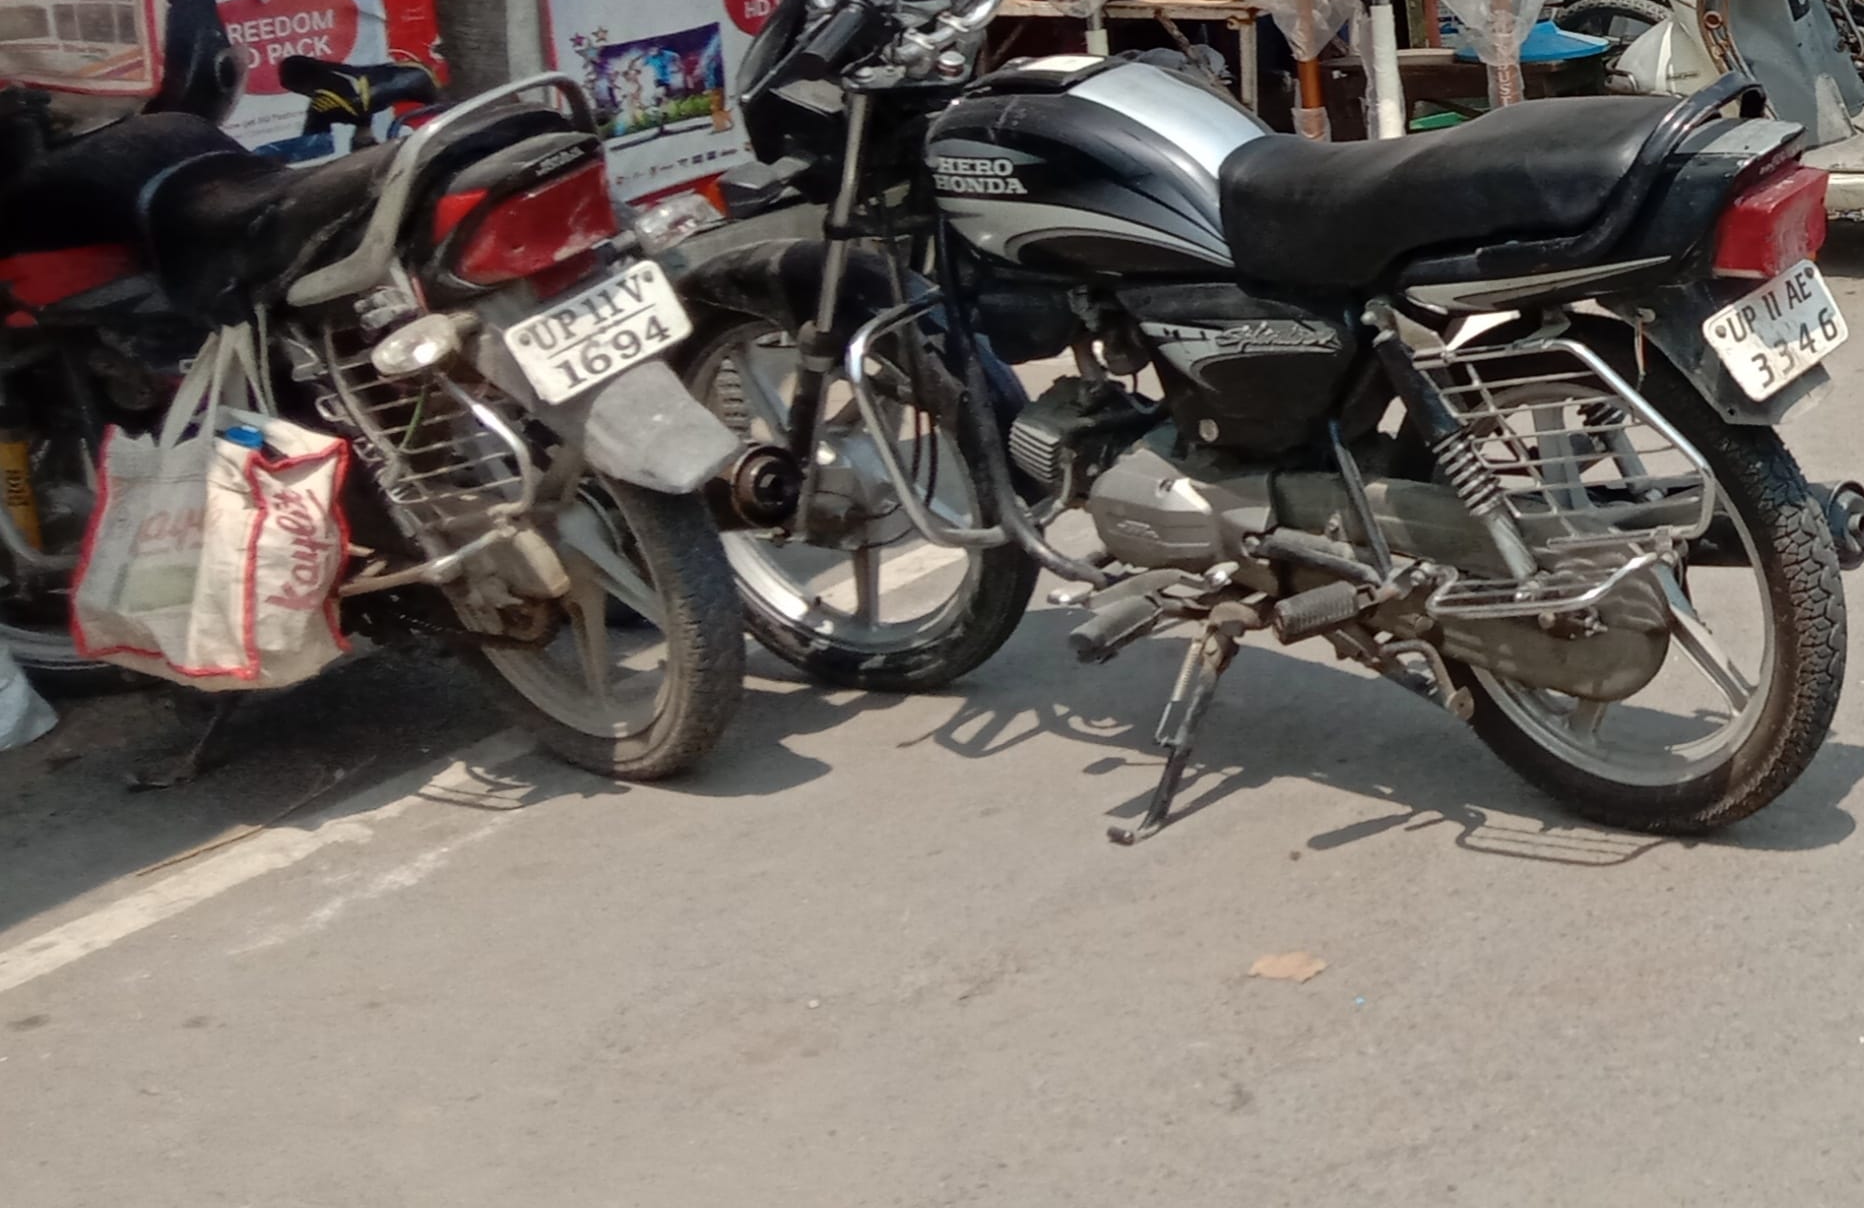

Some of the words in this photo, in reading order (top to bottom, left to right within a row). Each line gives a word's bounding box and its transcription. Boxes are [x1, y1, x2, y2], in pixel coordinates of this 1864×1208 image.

[267, 37, 333, 65] PACK
[932, 173, 1029, 194] HONDA
[936, 156, 1014, 177] HERO
[526, 307, 577, 351] UP
[1727, 305, 1757, 343] UP
[1761, 290, 1783, 321] 11
[1784, 272, 1812, 311] AE
[553, 314, 674, 390] 1694
[1751, 306, 1839, 389] 3346
